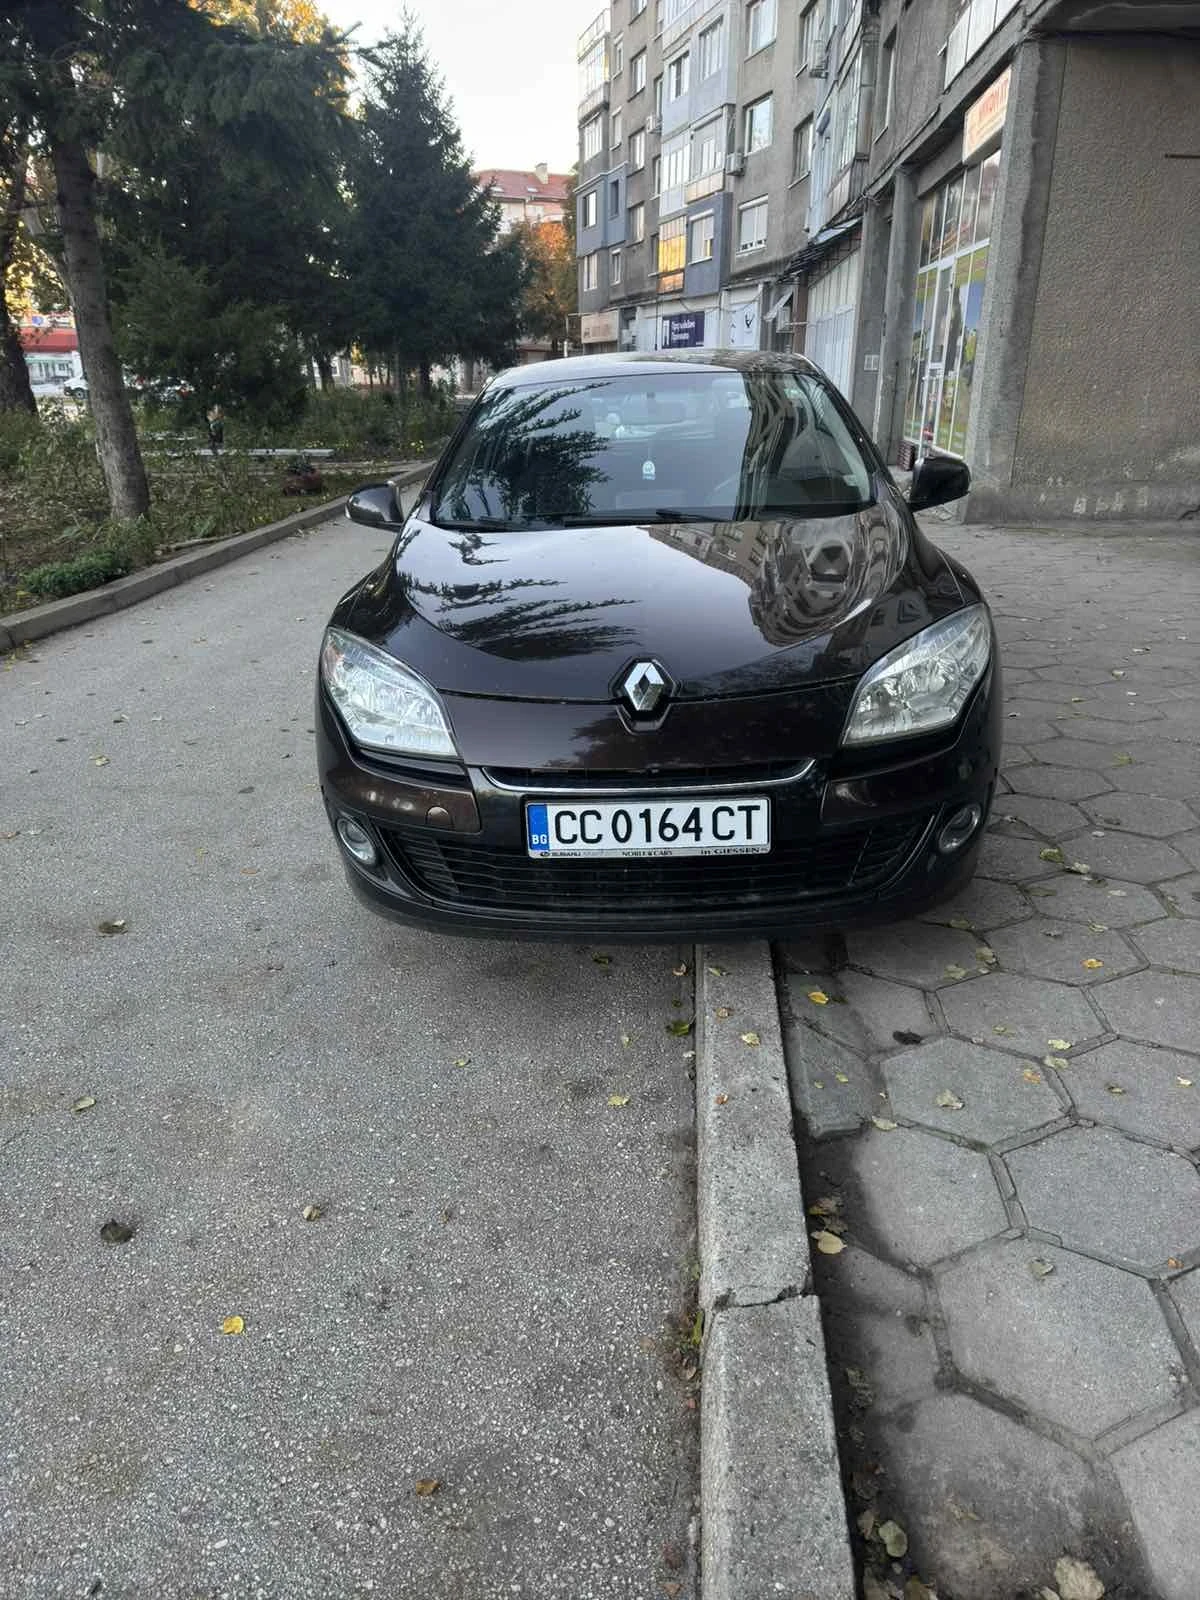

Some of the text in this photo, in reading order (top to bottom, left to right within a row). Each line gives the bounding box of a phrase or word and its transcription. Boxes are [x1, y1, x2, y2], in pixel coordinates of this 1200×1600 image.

[554, 805, 761, 844] CC 0164 CT
[531, 834, 548, 845] BG
